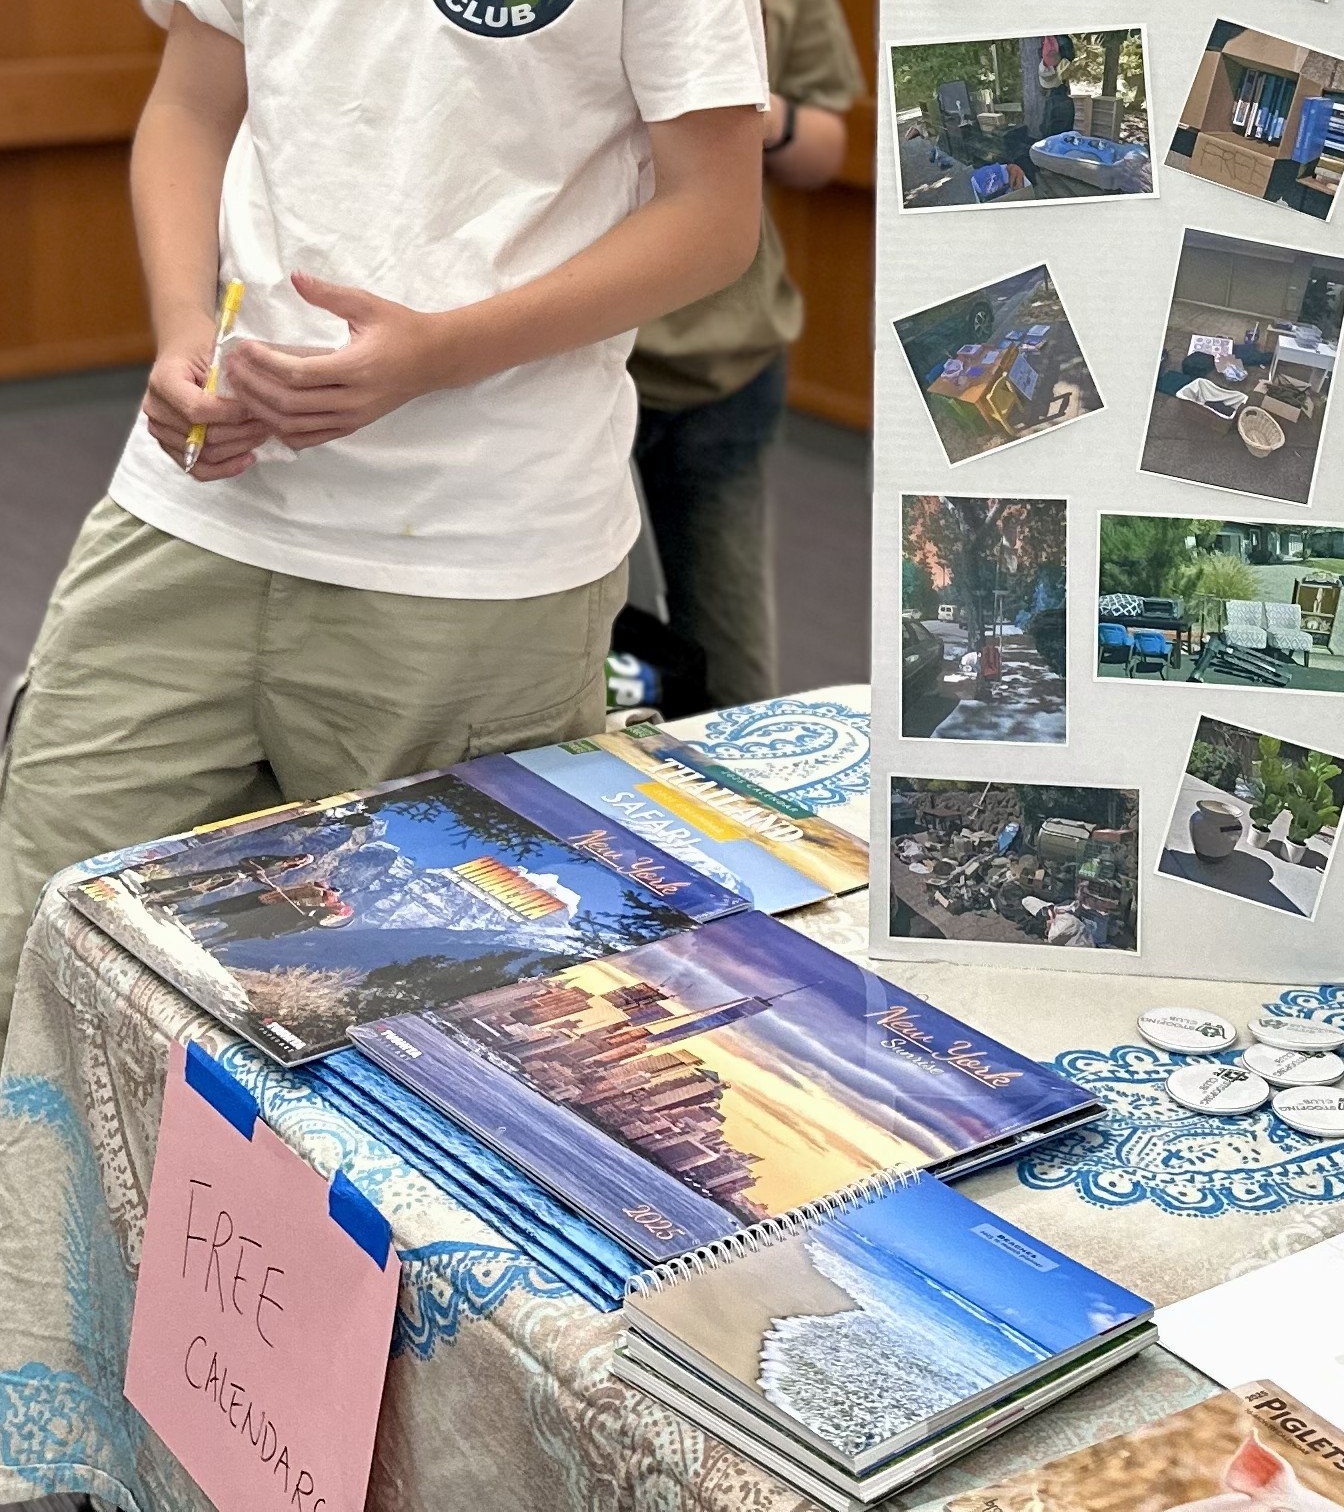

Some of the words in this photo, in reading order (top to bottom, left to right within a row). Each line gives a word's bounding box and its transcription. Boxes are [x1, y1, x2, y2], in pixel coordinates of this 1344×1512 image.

[1200, 140, 1271, 188] FREE
[601, 791, 702, 849] SAFARI
[652, 757, 805, 843] THAILAND
[568, 829, 622, 860] New
[618, 855, 692, 896] York
[864, 1005, 934, 1044] New
[931, 1040, 1024, 1088] York
[880, 1038, 945, 1076] Sunrise
[621, 1205, 686, 1240] 2025
[183, 1179, 285, 1348] FREE
